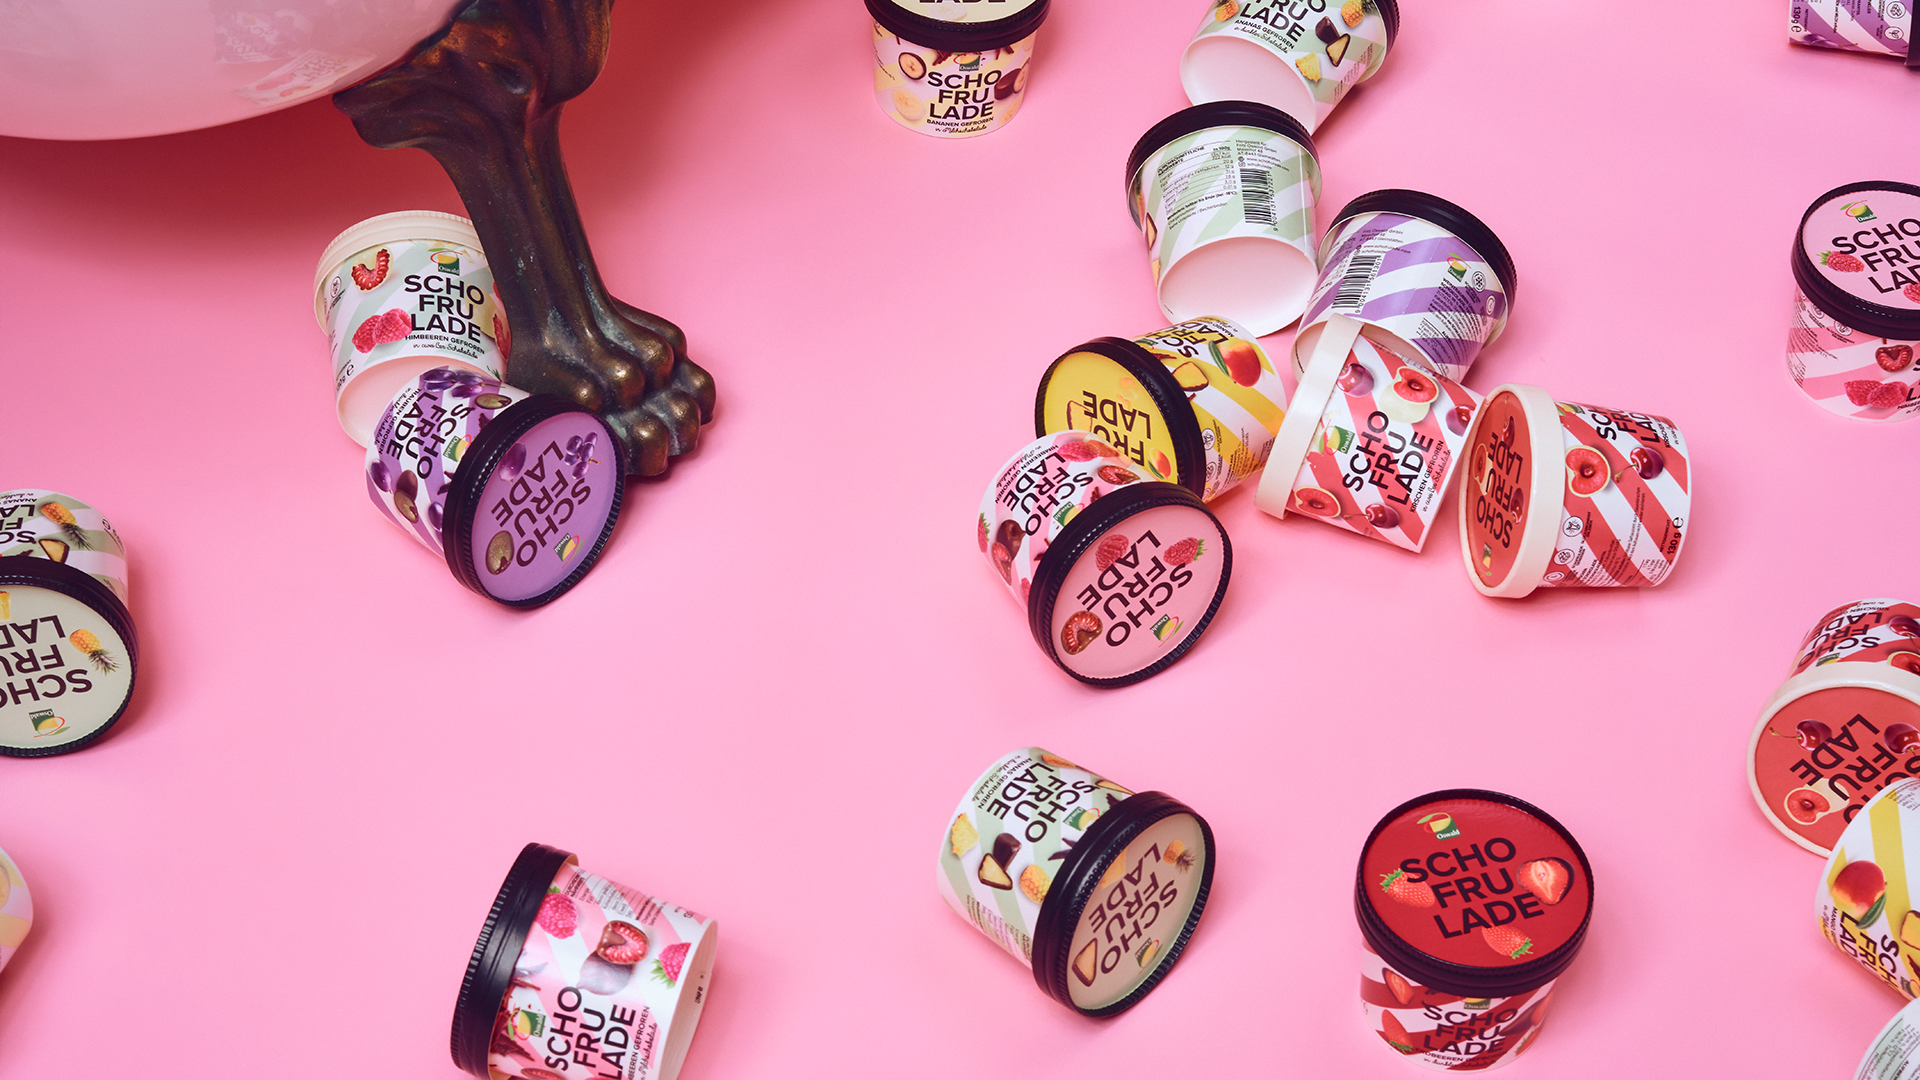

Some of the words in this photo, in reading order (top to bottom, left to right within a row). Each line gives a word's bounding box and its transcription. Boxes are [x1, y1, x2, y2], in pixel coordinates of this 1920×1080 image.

[1240, 3, 1305, 42] LADE
[1256, 0, 1308, 20] RU
[1235, 20, 1261, 29] ANANAS
[1262, 27, 1294, 49] GEFROREN
[928, 70, 1001, 89] SCHO
[938, 88, 989, 105] FRU
[930, 101, 994, 120] LADE
[960, 117, 994, 127] GEFROREN
[1832, 218, 1920, 255] SCHO
[404, 274, 485, 305] SCHO
[438, 265, 460, 274] Oswald
[1868, 264, 1920, 293] LA
[410, 313, 481, 344] LADE
[419, 294, 474, 320] FRU
[450, 337, 485, 354] GEFROREN
[1146, 332, 1199, 358] SCH
[1180, 322, 1229, 344] LAD
[379, 416, 398, 454] GEFROREN
[386, 392, 438, 460] LADE
[405, 404, 451, 459] FRU
[1082, 390, 1152, 440] LADE
[1588, 407, 1617, 440] SCH
[1629, 413, 1660, 443] LAD
[416, 403, 475, 480] SCHO
[1021, 445, 1058, 470] HIMBEEREN
[1340, 430, 1356, 453] Oswald
[1342, 411, 1389, 492] SCHO
[1368, 431, 1407, 490] FRU
[1487, 432, 1523, 484] LADE
[491, 440, 564, 527] LADE
[995, 470, 1021, 504] GEFROREN
[1003, 451, 1066, 512] LADE
[1019, 466, 1070, 513] FRU
[1387, 432, 1434, 505] LADE
[1410, 479, 1427, 513] KIRSCHEN
[1424, 440, 1444, 478] GEFROREN
[1486, 468, 1513, 512] FRU
[0, 505, 35, 518] LA
[514, 469, 569, 538] FRU
[516, 477, 591, 567] SCHO
[1024, 472, 1094, 536] SCHO
[1476, 495, 1513, 549] SCHO
[0, 531, 36, 544] SC
[1667, 540, 1678, 554] 130
[1076, 529, 1162, 612] LADE
[1103, 555, 1167, 621] FRU
[1105, 563, 1193, 647] SCHO
[0, 615, 66, 649] LAD
[1798, 637, 1880, 668] SCHO
[1811, 624, 1869, 650] FRU
[1007, 758, 1032, 774] ANANAS
[1789, 714, 1880, 787] LADE
[1828, 742, 1898, 802] FRU
[978, 775, 1008, 809] GEFROREN
[986, 762, 1054, 820] LADE
[1014, 773, 1067, 822] FRU
[1025, 780, 1098, 844] SCHO
[1436, 829, 1461, 840] Oswald
[1400, 838, 1516, 883] SCHO
[1088, 842, 1162, 933] LADE
[1104, 872, 1160, 944] FRU
[1431, 868, 1514, 909] FRU
[1100, 879, 1178, 975] SCHO
[1433, 892, 1545, 939] LADE
[1840, 911, 1859, 958] LAD
[1879, 934, 1899, 988] SCH
[544, 986, 583, 1072] SCHO
[1423, 1004, 1518, 1026] SCHO
[1436, 1023, 1501, 1041] FRU
[573, 1007, 606, 1069] FRU
[598, 1004, 636, 1080] LADE
[628, 1052, 638, 1080] MBEEREN
[633, 1006, 650, 1050] GEFROREN
[1423, 1035, 1506, 1055] LADE
